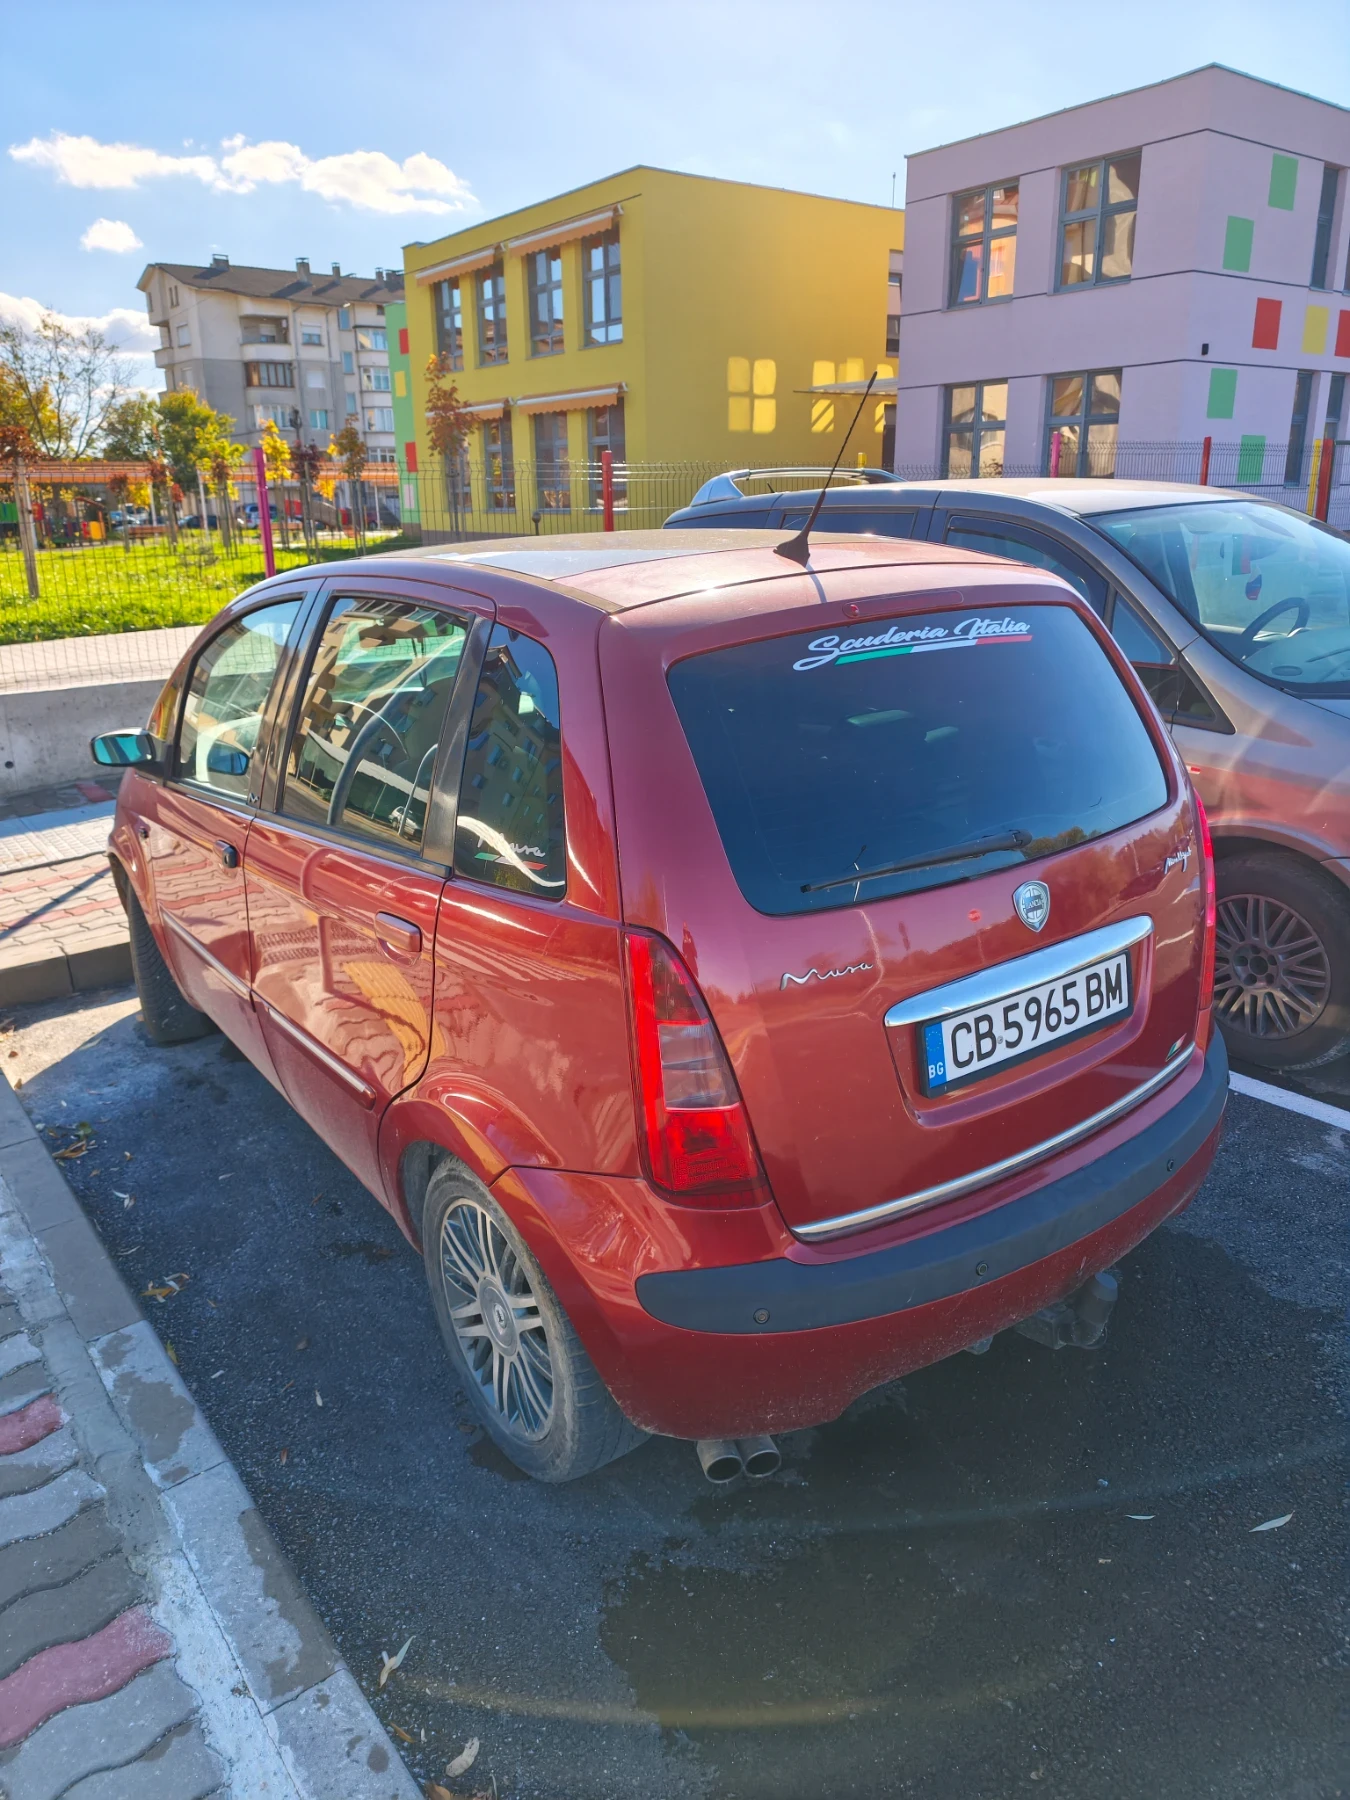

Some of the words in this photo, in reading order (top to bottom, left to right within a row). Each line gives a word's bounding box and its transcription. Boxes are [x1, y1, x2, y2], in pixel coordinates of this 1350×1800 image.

[792, 626, 949, 671] Scuderia
[953, 617, 1031, 640] Italia
[780, 962, 873, 991] Musa
[928, 1062, 944, 1079] BG
